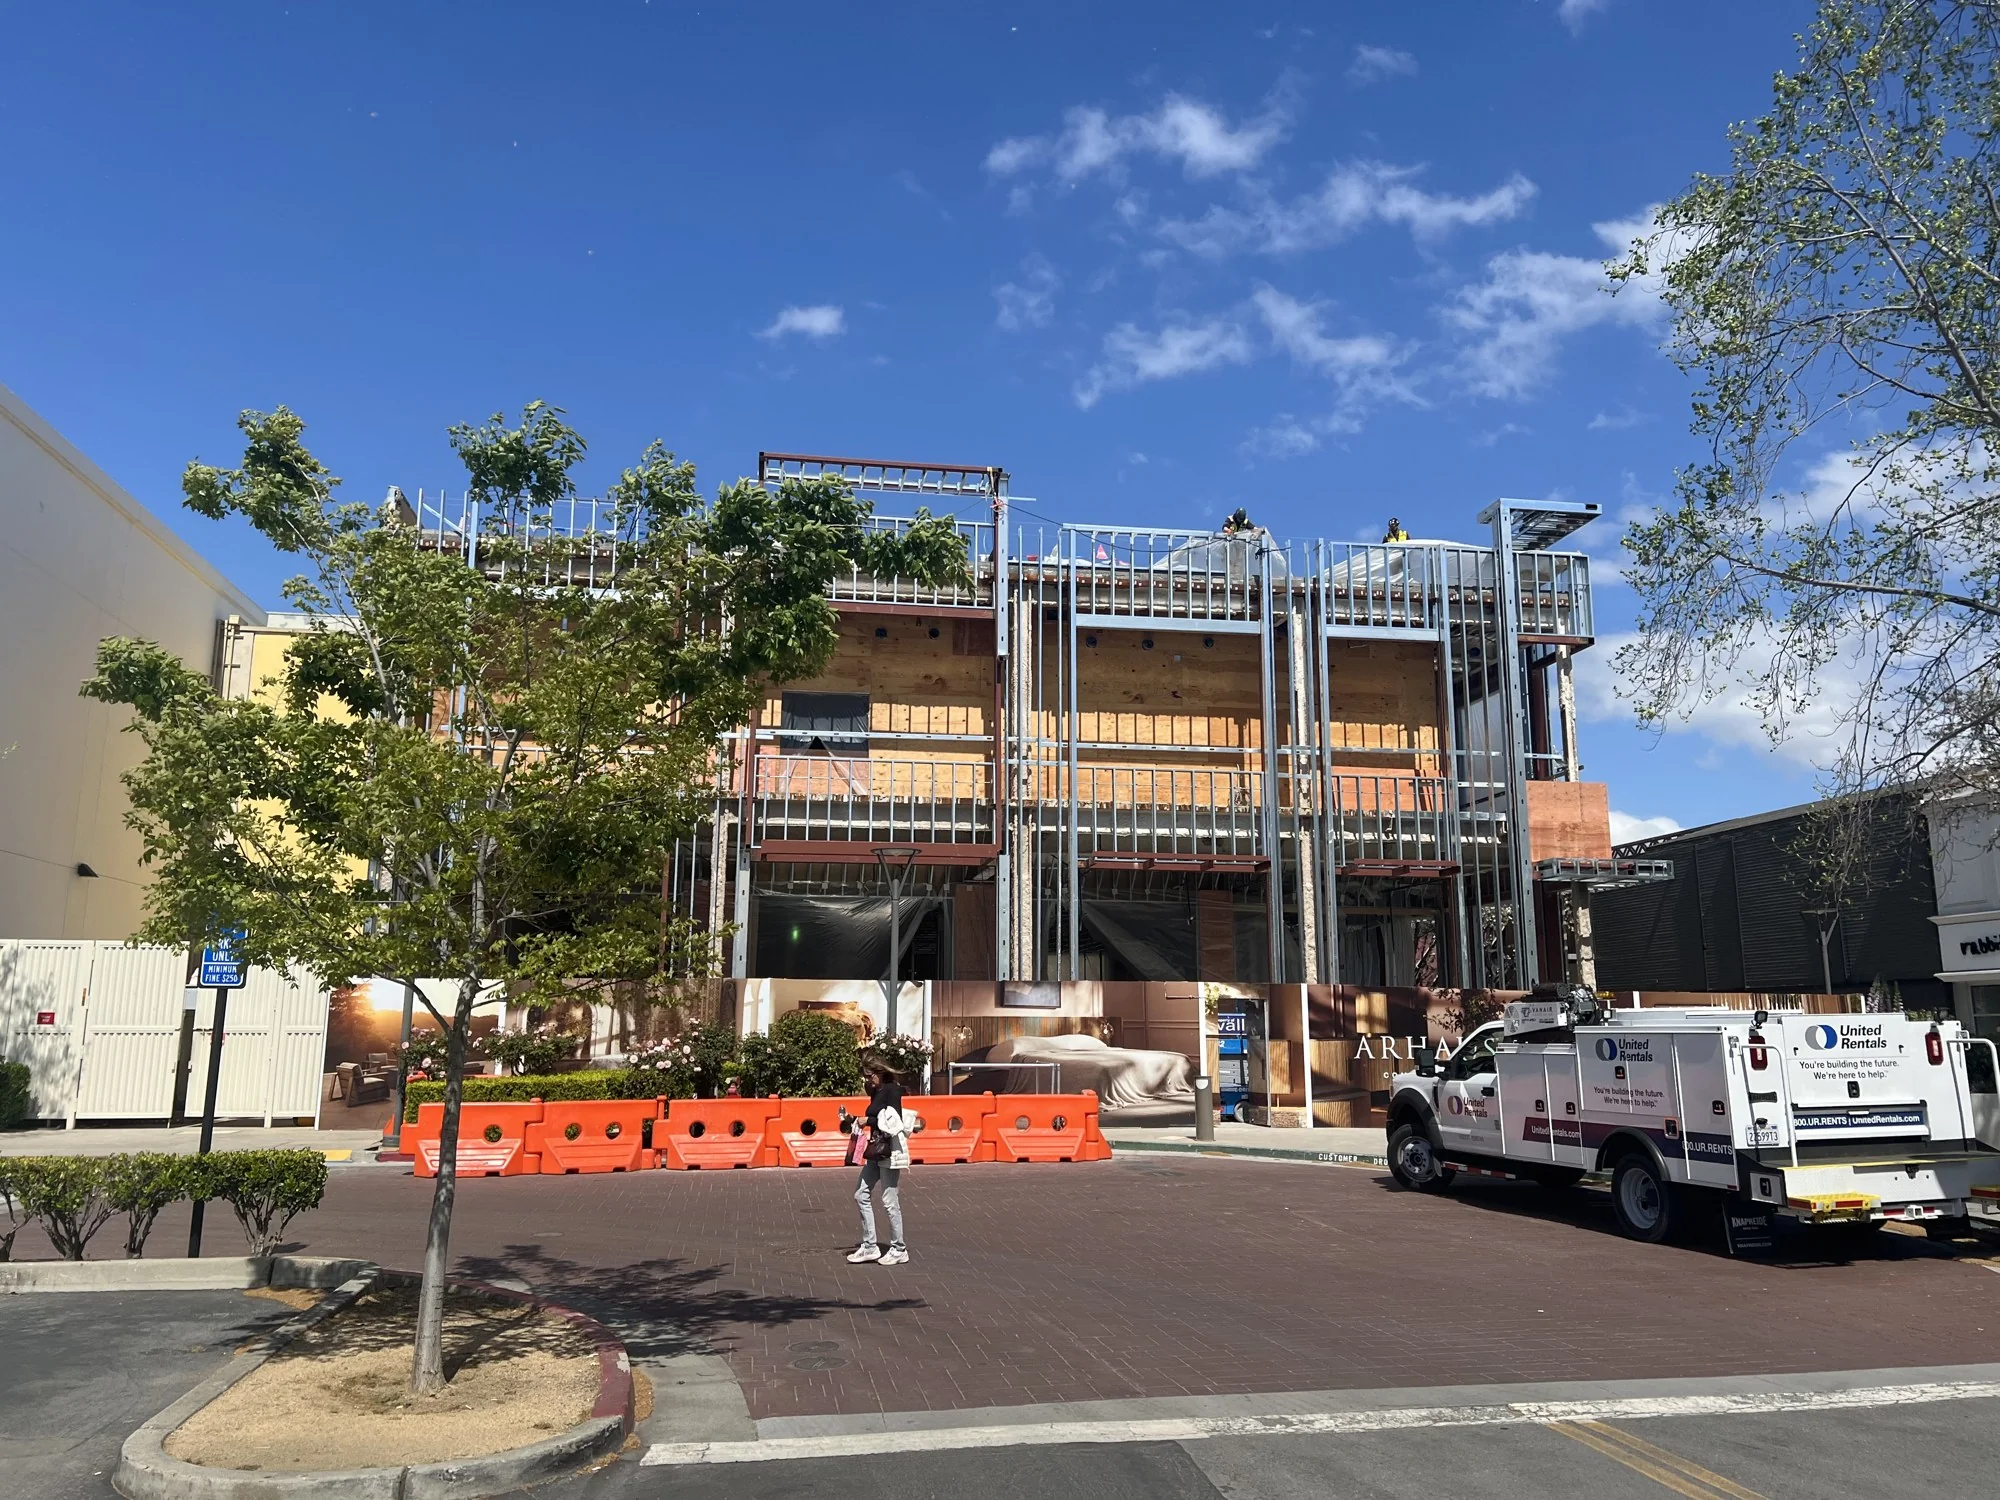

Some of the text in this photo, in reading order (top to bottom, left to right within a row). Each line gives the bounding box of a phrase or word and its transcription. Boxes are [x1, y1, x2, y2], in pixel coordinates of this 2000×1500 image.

[208, 965, 237, 974] MINIMUM
[205, 974, 238, 983] FINE $250
[1840, 1024, 1881, 1036] United
[1618, 1038, 1649, 1050] United
[1841, 1036, 1887, 1049] Rentals
[1620, 1050, 1653, 1062] Rentals
[1800, 1059, 1899, 1070] You're building the future.
[1814, 1071, 1836, 1080] We're
[1838, 1071, 1856, 1079] here
[1594, 1086, 1610, 1094] You're
[1612, 1088, 1634, 1097] building
[1645, 1090, 1664, 1098] future.
[1464, 1097, 1485, 1107] United
[1604, 1096, 1619, 1104] We're
[1465, 1107, 1488, 1117] Rentals
[1852, 1114, 1920, 1124] UnitedRentals.com
[1318, 1153, 1358, 1162] CUSTOMER
